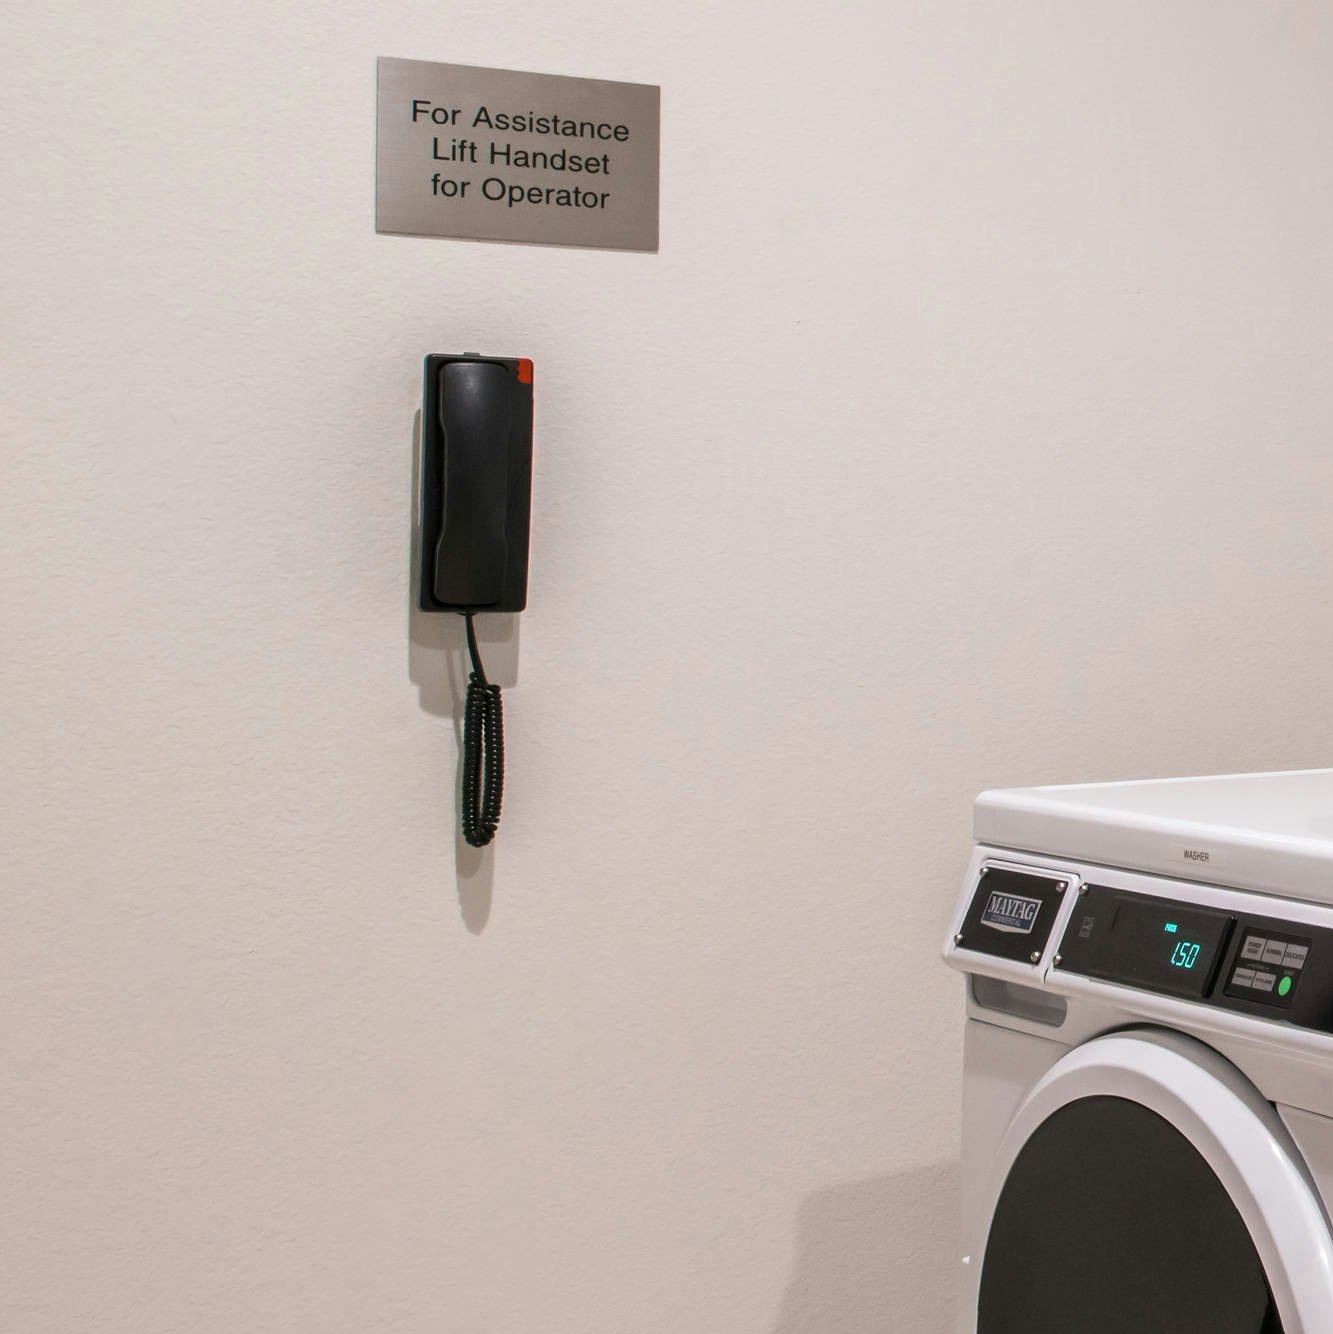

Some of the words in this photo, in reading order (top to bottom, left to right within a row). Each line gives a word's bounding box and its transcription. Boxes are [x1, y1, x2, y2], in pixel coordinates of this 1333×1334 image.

[411, 99, 462, 126] For
[472, 105, 630, 142] Assistance
[432, 136, 478, 164] Lift
[490, 142, 610, 175] Handset
[431, 173, 471, 198] for
[481, 177, 610, 209] Operator
[1183, 849, 1210, 862] WASHER
[987, 895, 1036, 920] MAYTAG
